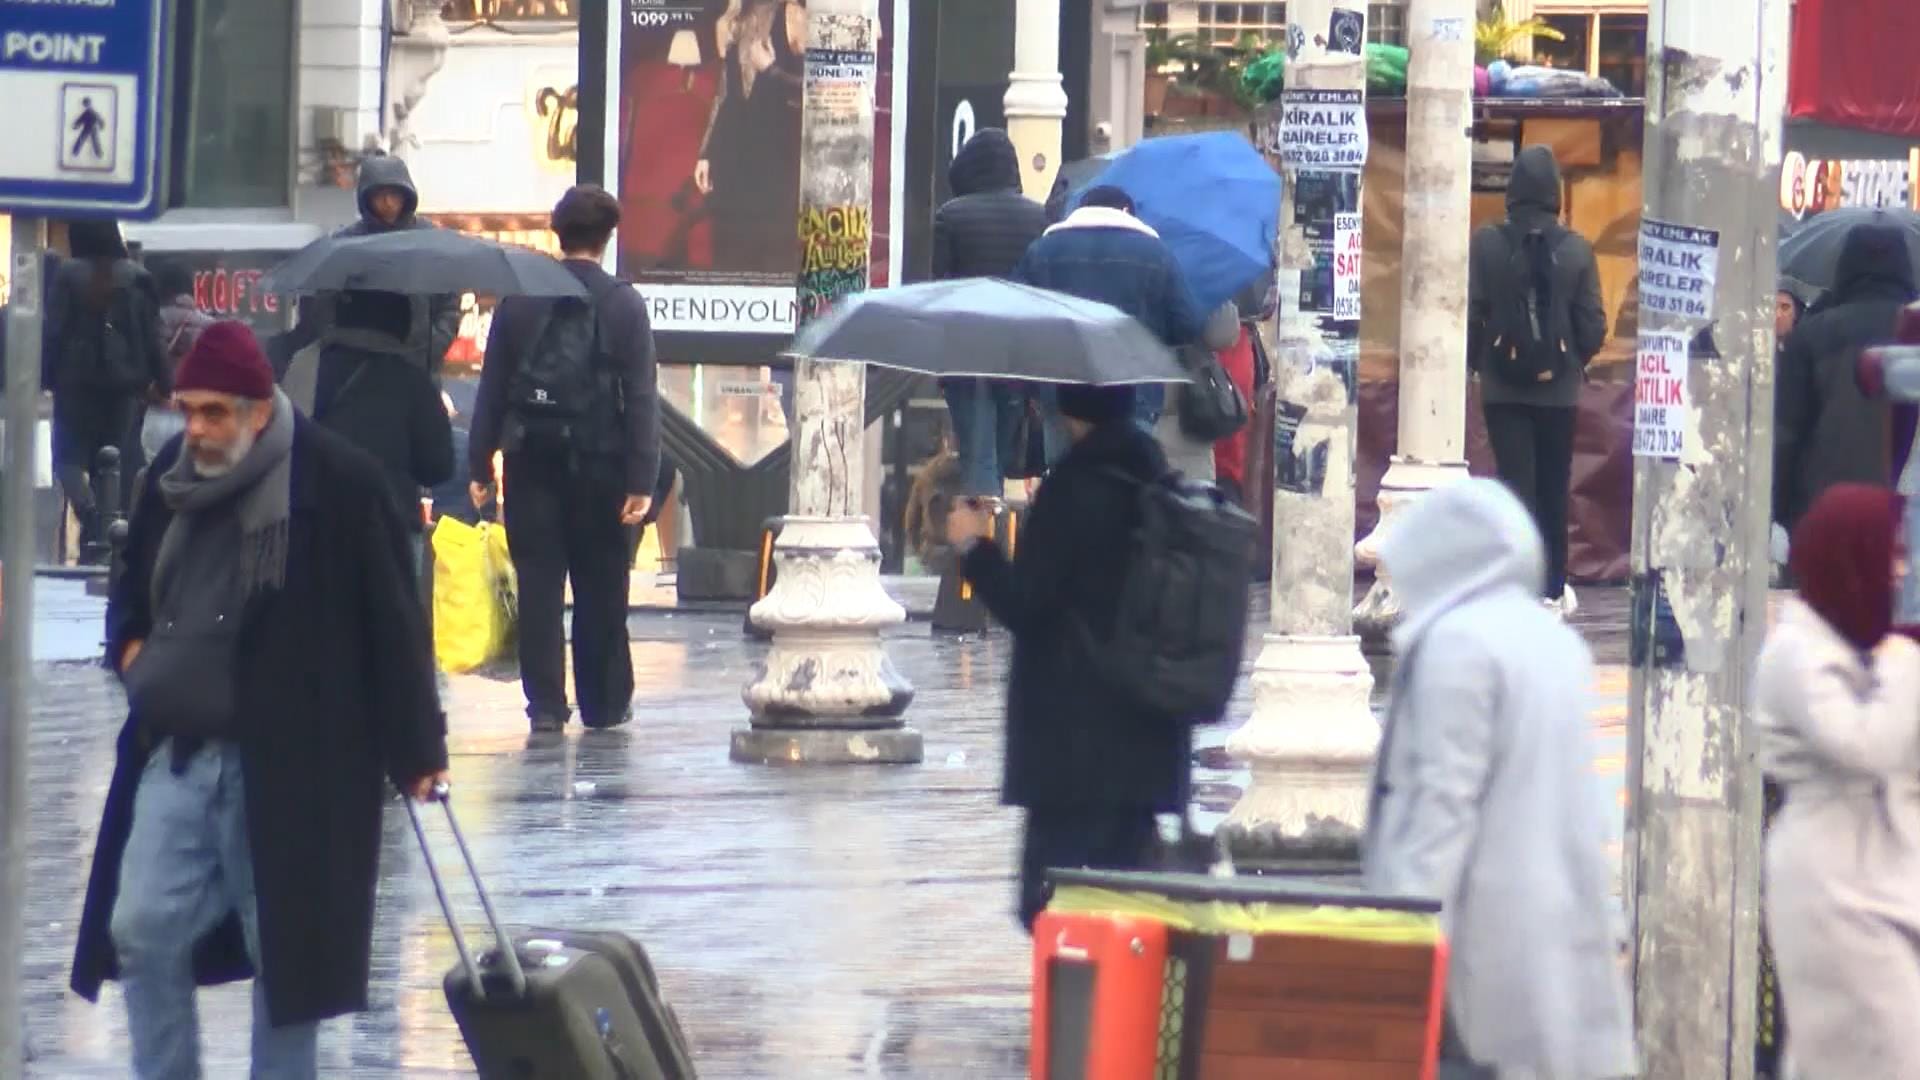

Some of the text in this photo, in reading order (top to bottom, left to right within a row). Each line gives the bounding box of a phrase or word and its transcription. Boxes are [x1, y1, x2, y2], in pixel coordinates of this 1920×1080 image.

[5, 31, 106, 63] POINT
[1319, 92, 1360, 102] EMLAK
[1284, 107, 1356, 126] KİRALIK
[1282, 128, 1359, 145] DAİRELER
[1663, 226, 1713, 246] EMLAK
